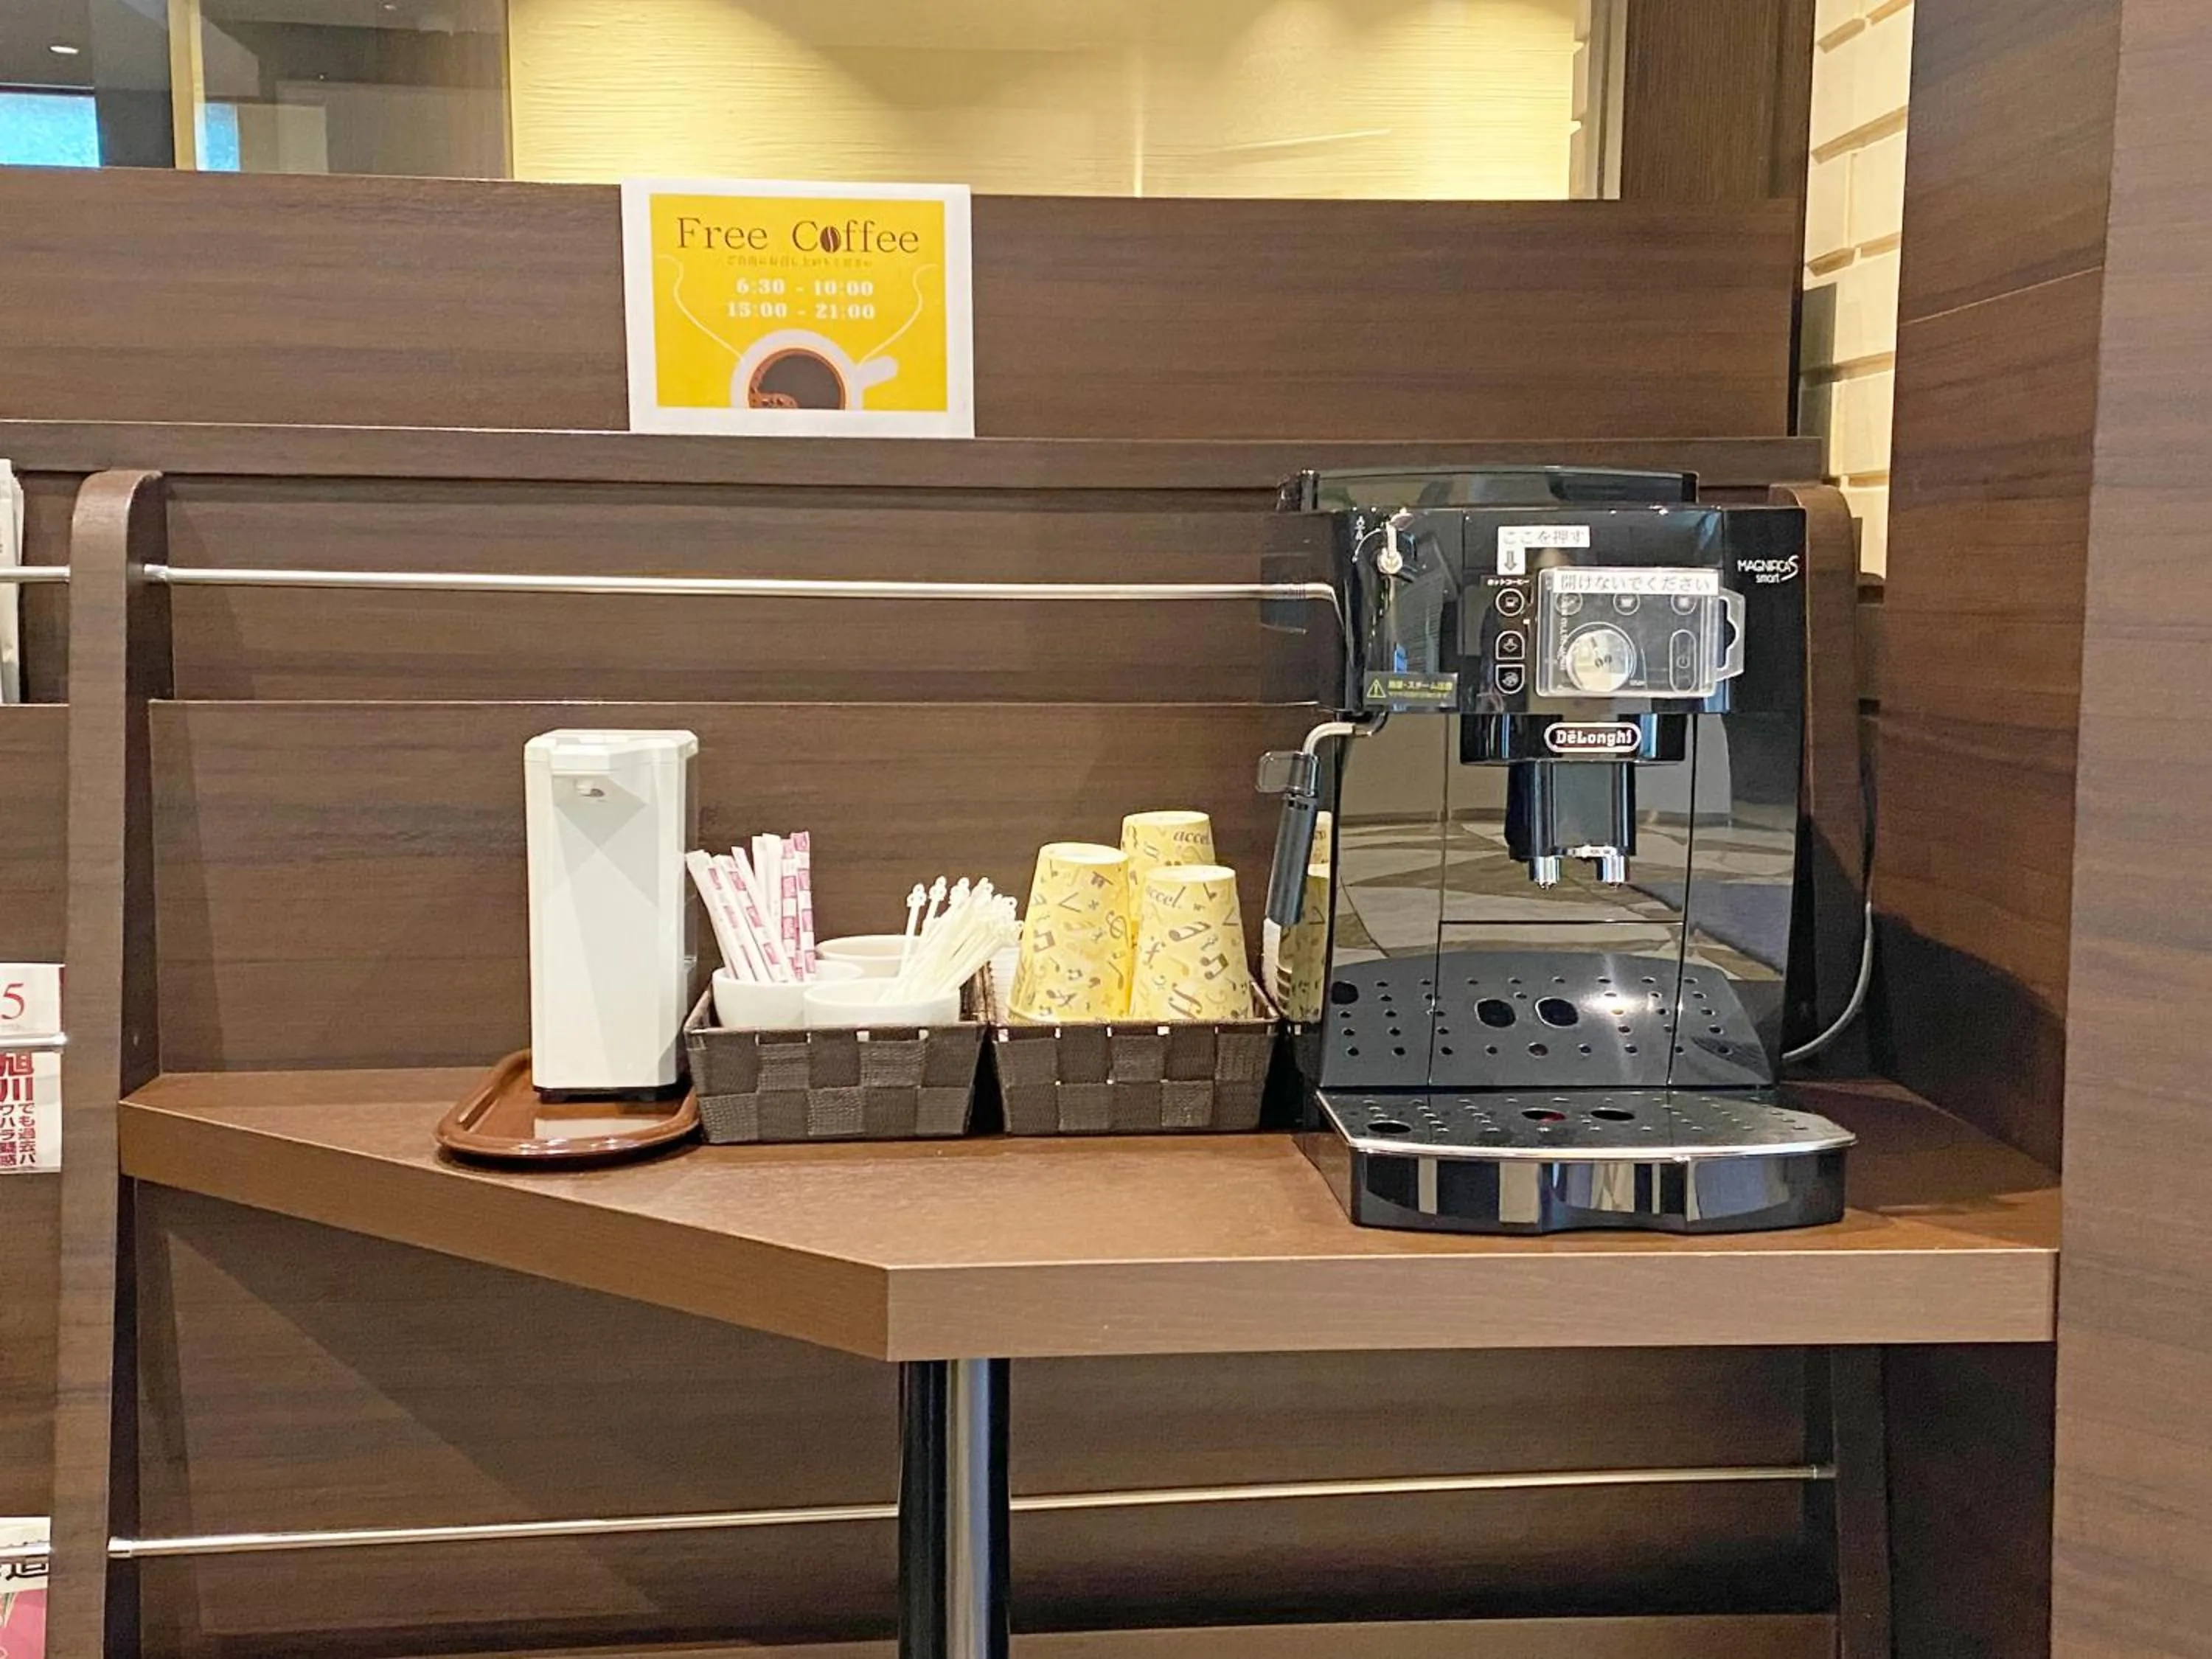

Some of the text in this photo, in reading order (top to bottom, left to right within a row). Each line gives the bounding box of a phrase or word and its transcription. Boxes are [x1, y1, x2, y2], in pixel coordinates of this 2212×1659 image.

[677, 217, 919, 254] Free Coffee
[736, 278, 785, 294] 6:30
[813, 279, 874, 296] 10:00
[726, 301, 787, 318] 15:00
[815, 302, 875, 319] 21:00
[1503, 530, 1585, 545] ここを押す
[1561, 574, 1710, 591] 開けないでください
[1, 982, 25, 1020] 5
